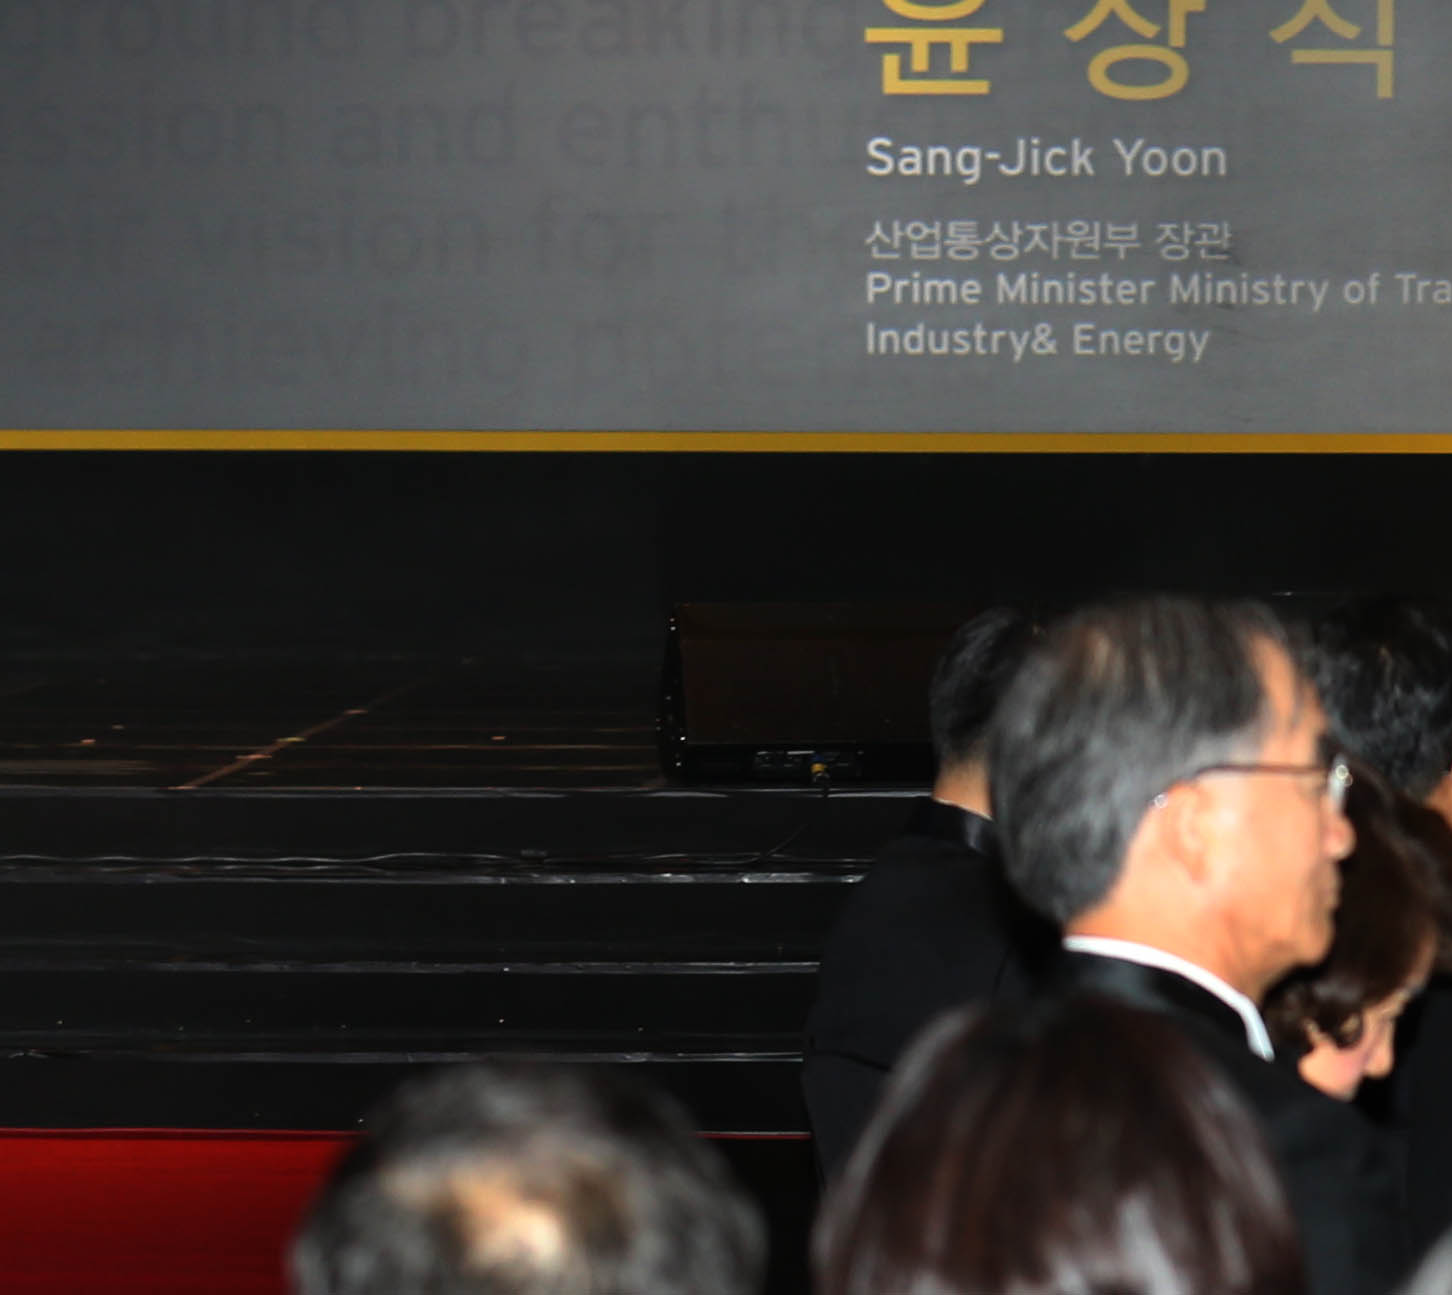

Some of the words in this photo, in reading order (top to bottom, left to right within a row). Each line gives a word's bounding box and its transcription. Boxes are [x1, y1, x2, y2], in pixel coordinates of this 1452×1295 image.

[329, 80, 519, 168] and
[867, 137, 1095, 186] Sang-Jick
[1113, 139, 1227, 178] Yoon
[866, 220, 1139, 262] 산업통상자원부
[1157, 223, 1232, 262] 장관
[868, 271, 982, 305] Prime
[998, 272, 1156, 306] Minister
[1171, 273, 1330, 313] Ministry
[1344, 273, 1381, 306] of
[868, 323, 1058, 362] Industry&
[1074, 321, 1210, 363] Energy
